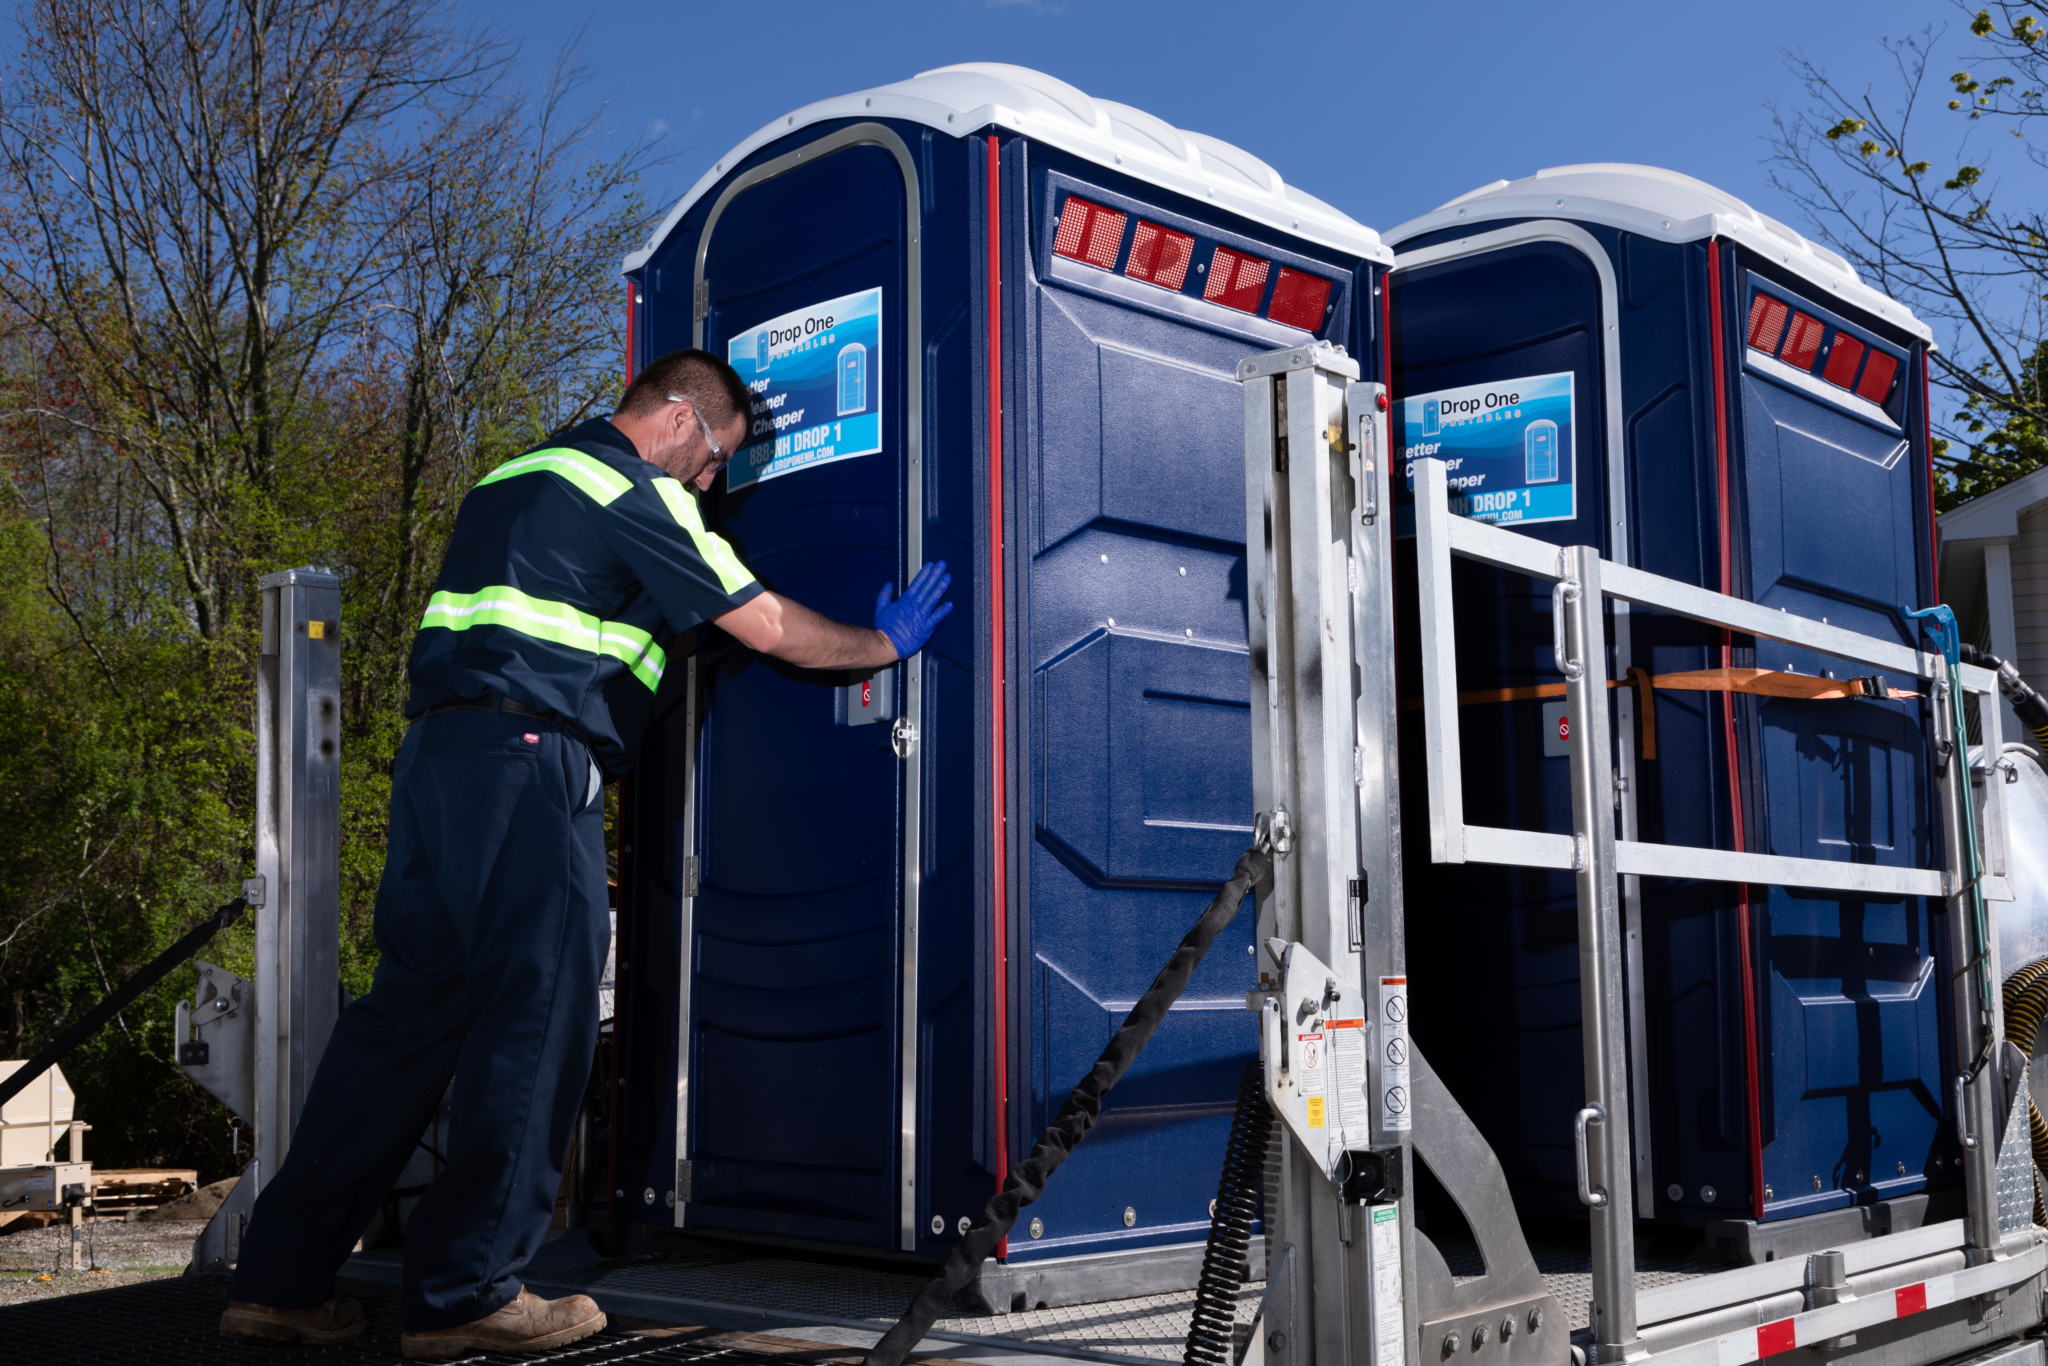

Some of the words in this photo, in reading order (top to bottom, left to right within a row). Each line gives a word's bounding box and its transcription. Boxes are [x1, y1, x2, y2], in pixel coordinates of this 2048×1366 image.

[770, 325, 801, 347] Drop
[805, 316, 834, 335] One
[770, 334, 835, 362] PORTABLES
[747, 377, 770, 396] tter
[751, 393, 787, 415] leaner
[1441, 399, 1480, 415] Drop
[1485, 392, 1520, 408] One
[753, 409, 804, 436] Cheaper
[1441, 410, 1522, 428] PORTABLES
[749, 436, 790, 467] 888-NH
[794, 425, 830, 453] DROP
[834, 422, 841, 442] 1
[1396, 442, 1441, 460] Better
[756, 445, 835, 477] WWW.DROPONENH.COM
[1447, 474, 1486, 491] aper
[1473, 491, 1517, 513] DROP
[1522, 489, 1530, 507] 1
